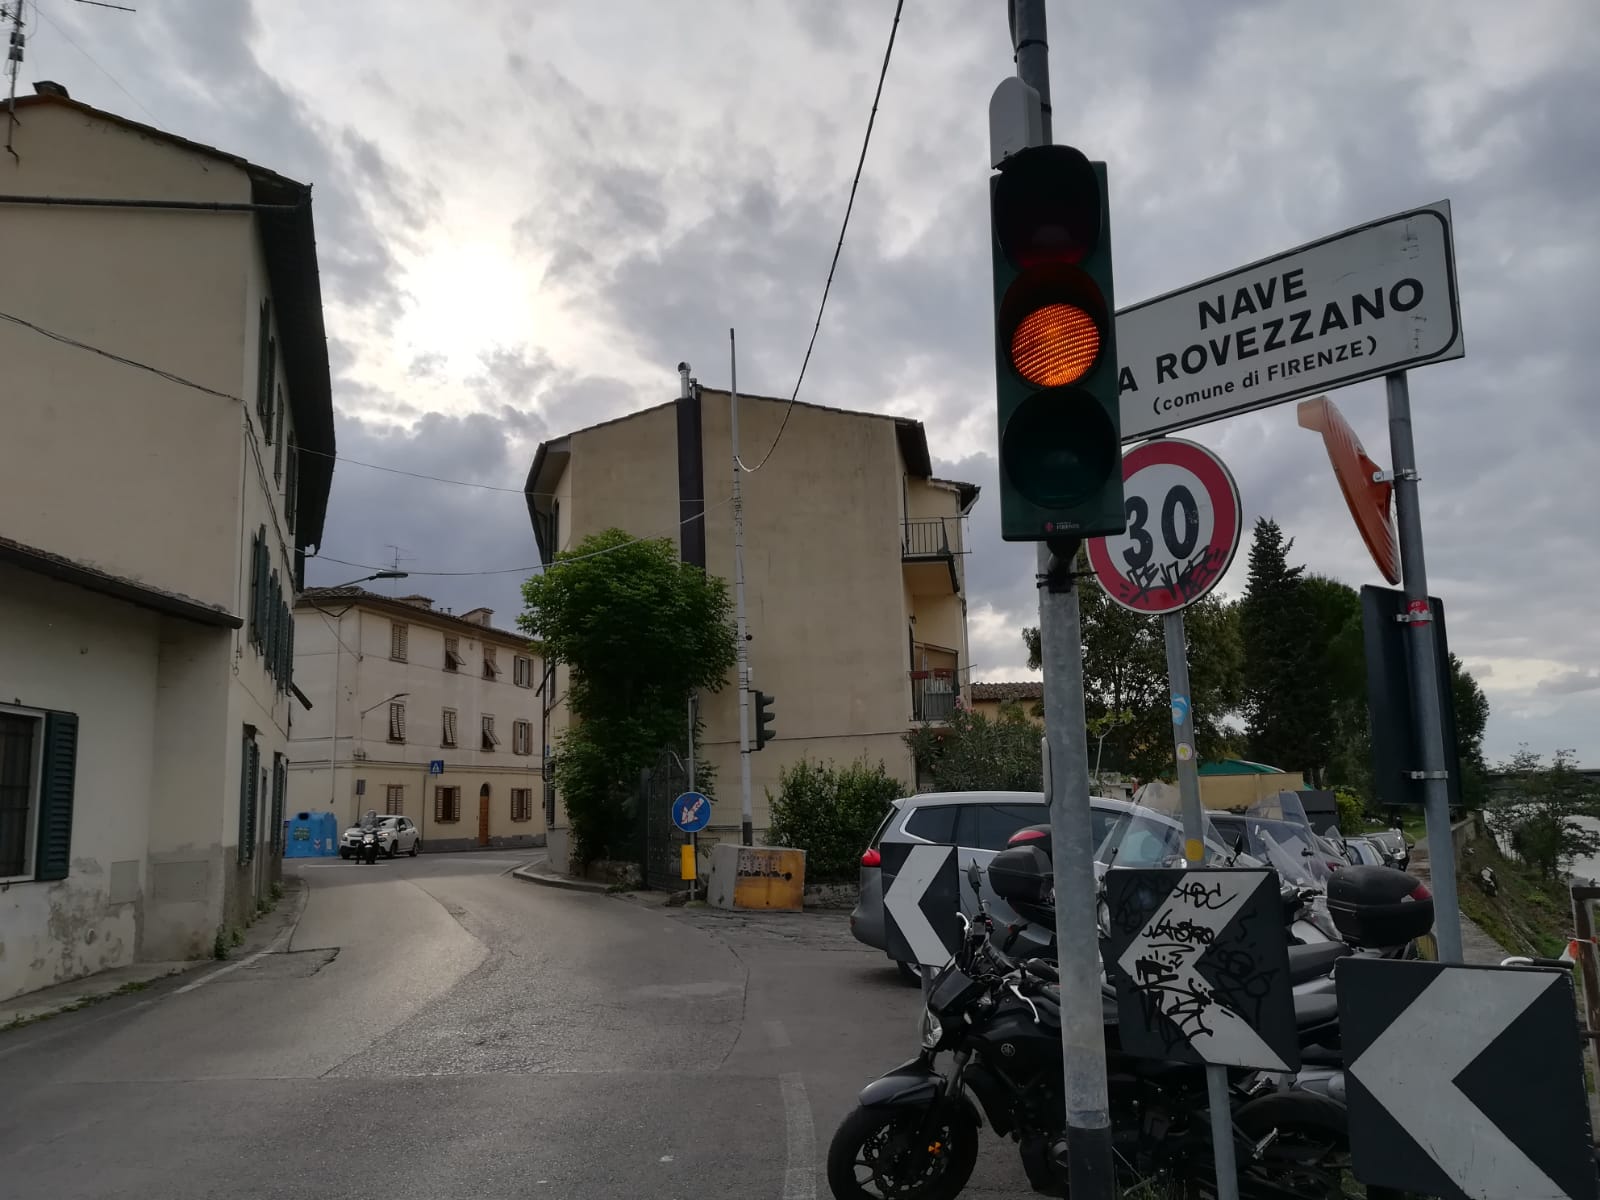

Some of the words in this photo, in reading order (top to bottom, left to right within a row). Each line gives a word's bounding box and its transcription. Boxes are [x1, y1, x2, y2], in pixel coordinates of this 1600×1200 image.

[1118, 366, 1139, 396] A
[1156, 278, 1424, 385] ROVEZZANO
[1198, 268, 1307, 330] NAVE
[1153, 381, 1235, 415] (comune
[1243, 370, 1259, 388] di
[1267, 335, 1377, 381] FIRENZE)
[1123, 484, 1200, 568] 30
